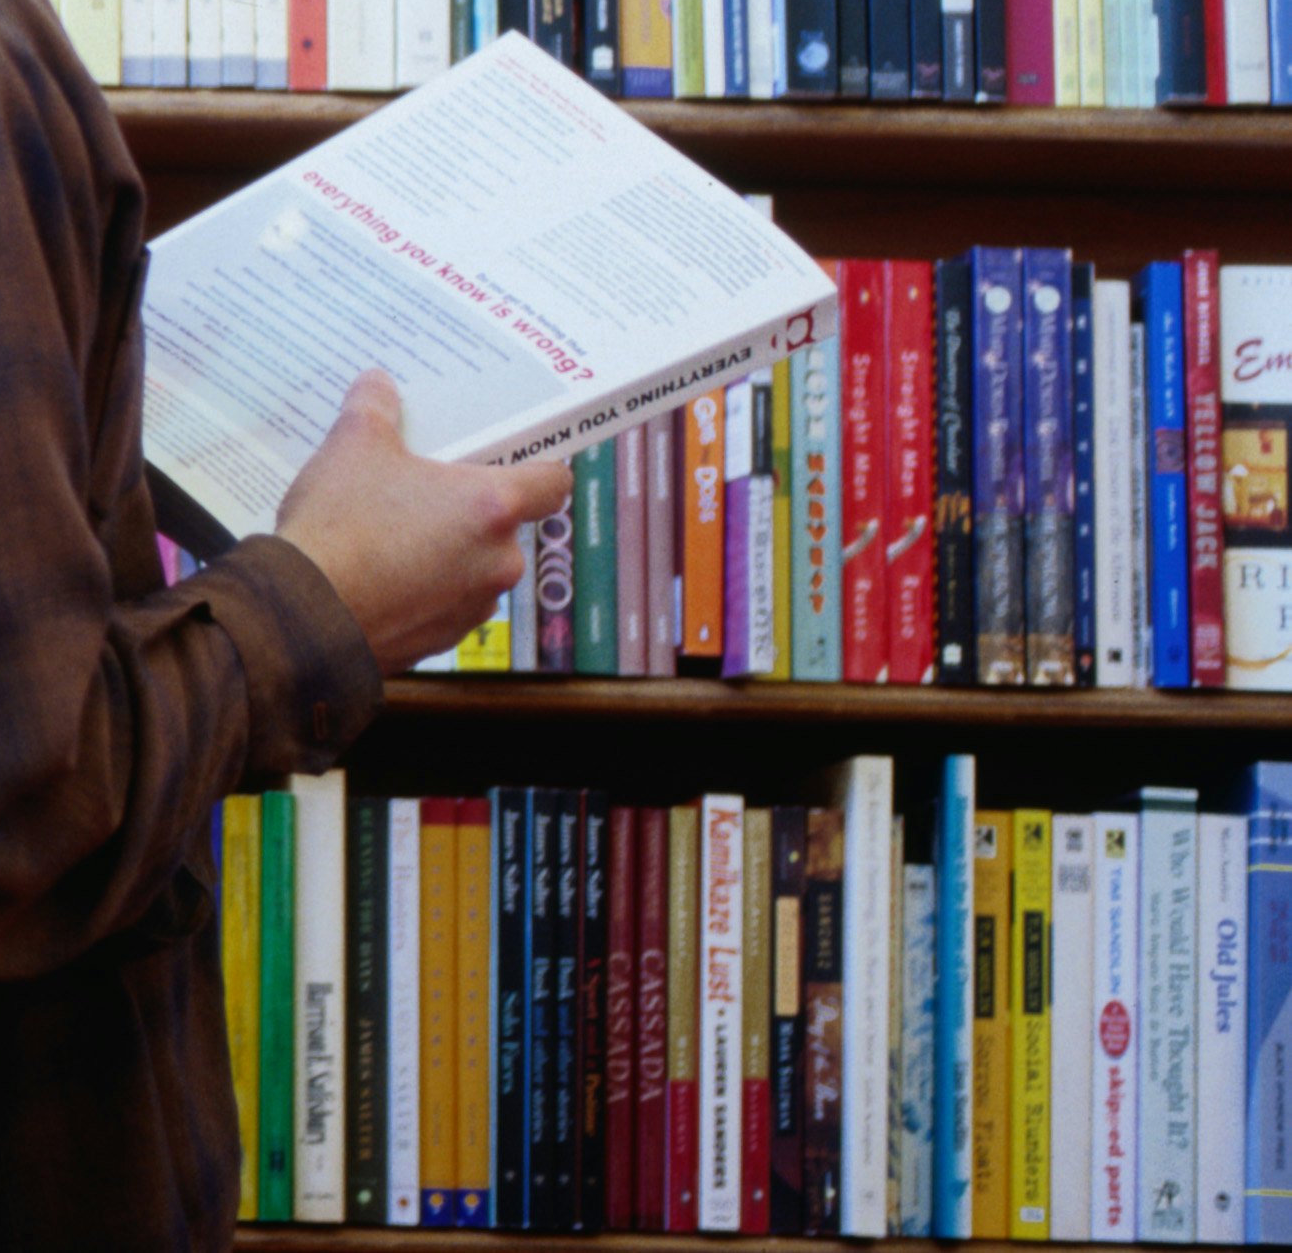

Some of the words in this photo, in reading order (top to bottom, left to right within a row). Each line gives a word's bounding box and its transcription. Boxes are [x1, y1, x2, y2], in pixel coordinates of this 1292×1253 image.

[302, 170, 401, 244] everything
[393, 239, 439, 270] you
[434, 260, 493, 304] know
[487, 299, 514, 321] is
[510, 317, 596, 382] wrong?
[625, 345, 753, 413] EVERYTHING
[848, 353, 873, 444] Straight
[896, 349, 921, 442] Straight
[510, 426, 572, 464] KNOW
[577, 404, 620, 434] YOU
[1194, 393, 1218, 494] YELLOW
[854, 452, 873, 501] Man
[901, 448, 921, 498] Man
[1194, 502, 1218, 569] JACK
[853, 577, 874, 641] Russo
[901, 574, 921, 639] Russo
[708, 808, 740, 935] Kamikaze
[1109, 867, 1123, 904] TIM
[1169, 828, 1191, 879] Who
[1109, 907, 1123, 996] SANDLIN
[1169, 887, 1191, 954] Would
[1210, 917, 1238, 967] Old
[708, 946, 740, 1003] Lust
[1169, 963, 1191, 1019] Have
[1210, 969, 1238, 1035] Jules
[607, 951, 632, 1105] CASSADA
[640, 948, 665, 1104] CASSADA
[1025, 1020, 1045, 1092] Social
[711, 1022, 728, 1098] LAUREN
[1162, 1026, 1191, 1113] Thought
[711, 1103, 728, 1190] SANDERS
[1025, 1102, 1045, 1202] Blunders
[1169, 1121, 1191, 1151] It?
[1105, 1165, 1127, 1227] parts
